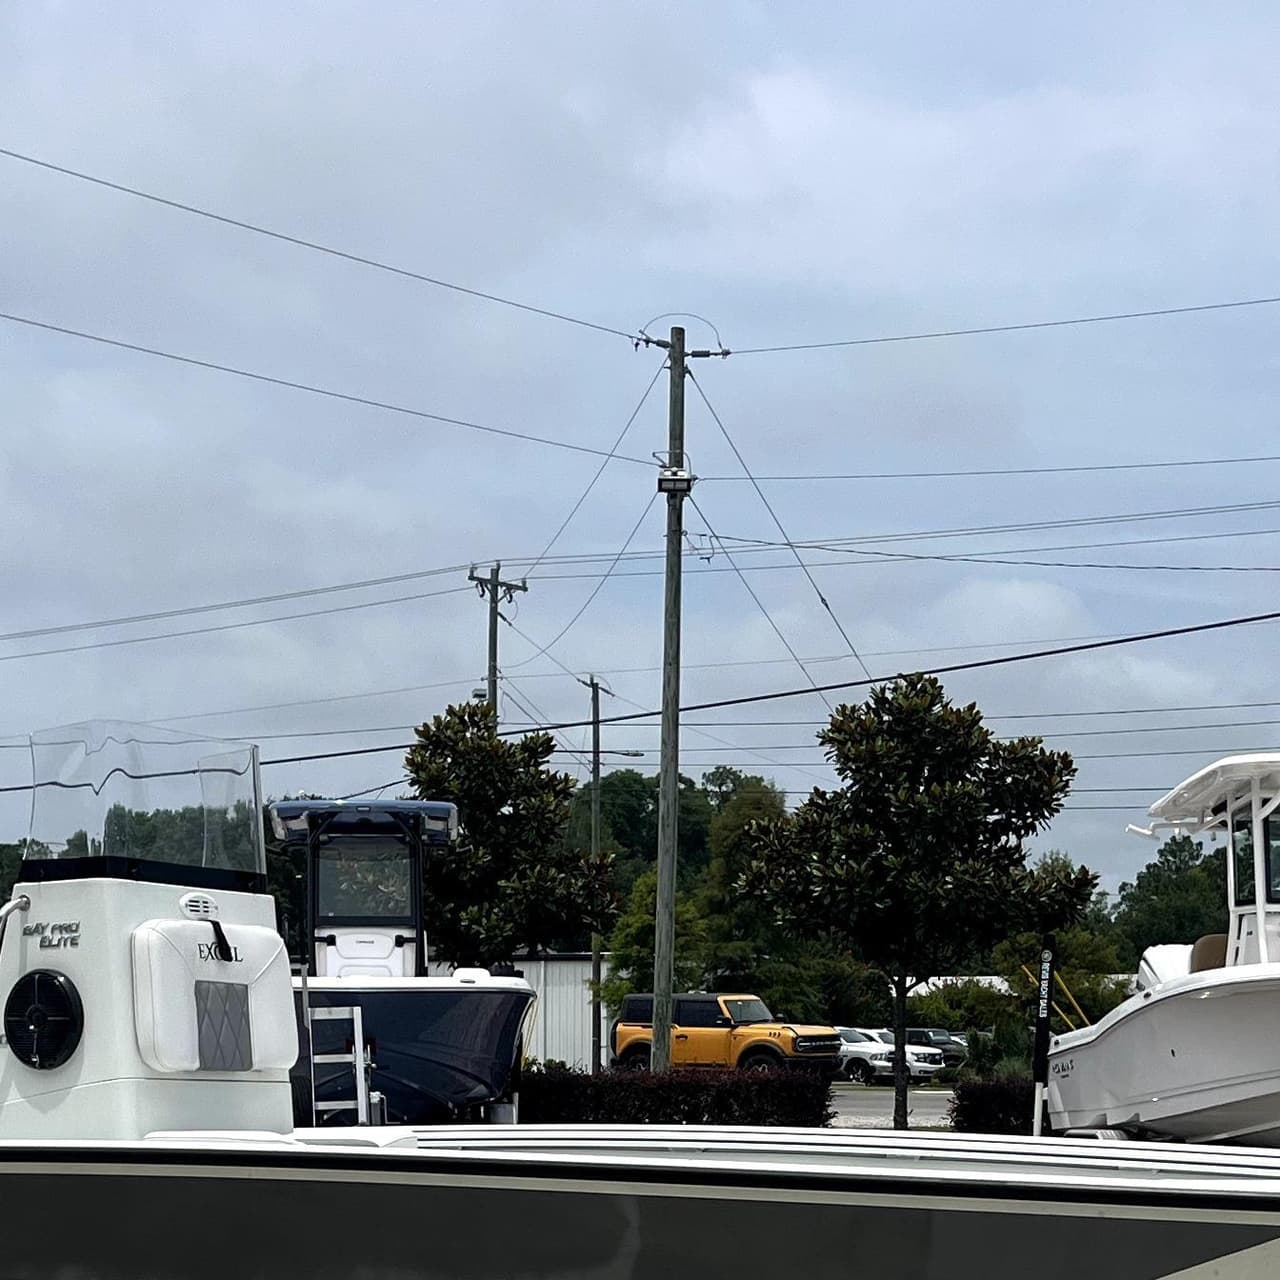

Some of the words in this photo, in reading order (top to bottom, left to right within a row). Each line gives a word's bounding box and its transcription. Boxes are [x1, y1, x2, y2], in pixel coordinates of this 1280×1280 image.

[23, 922, 49, 936] BAY
[51, 921, 80, 935] PRO
[39, 934, 81, 949] ELITE
[197, 941, 244, 962] EXCL
